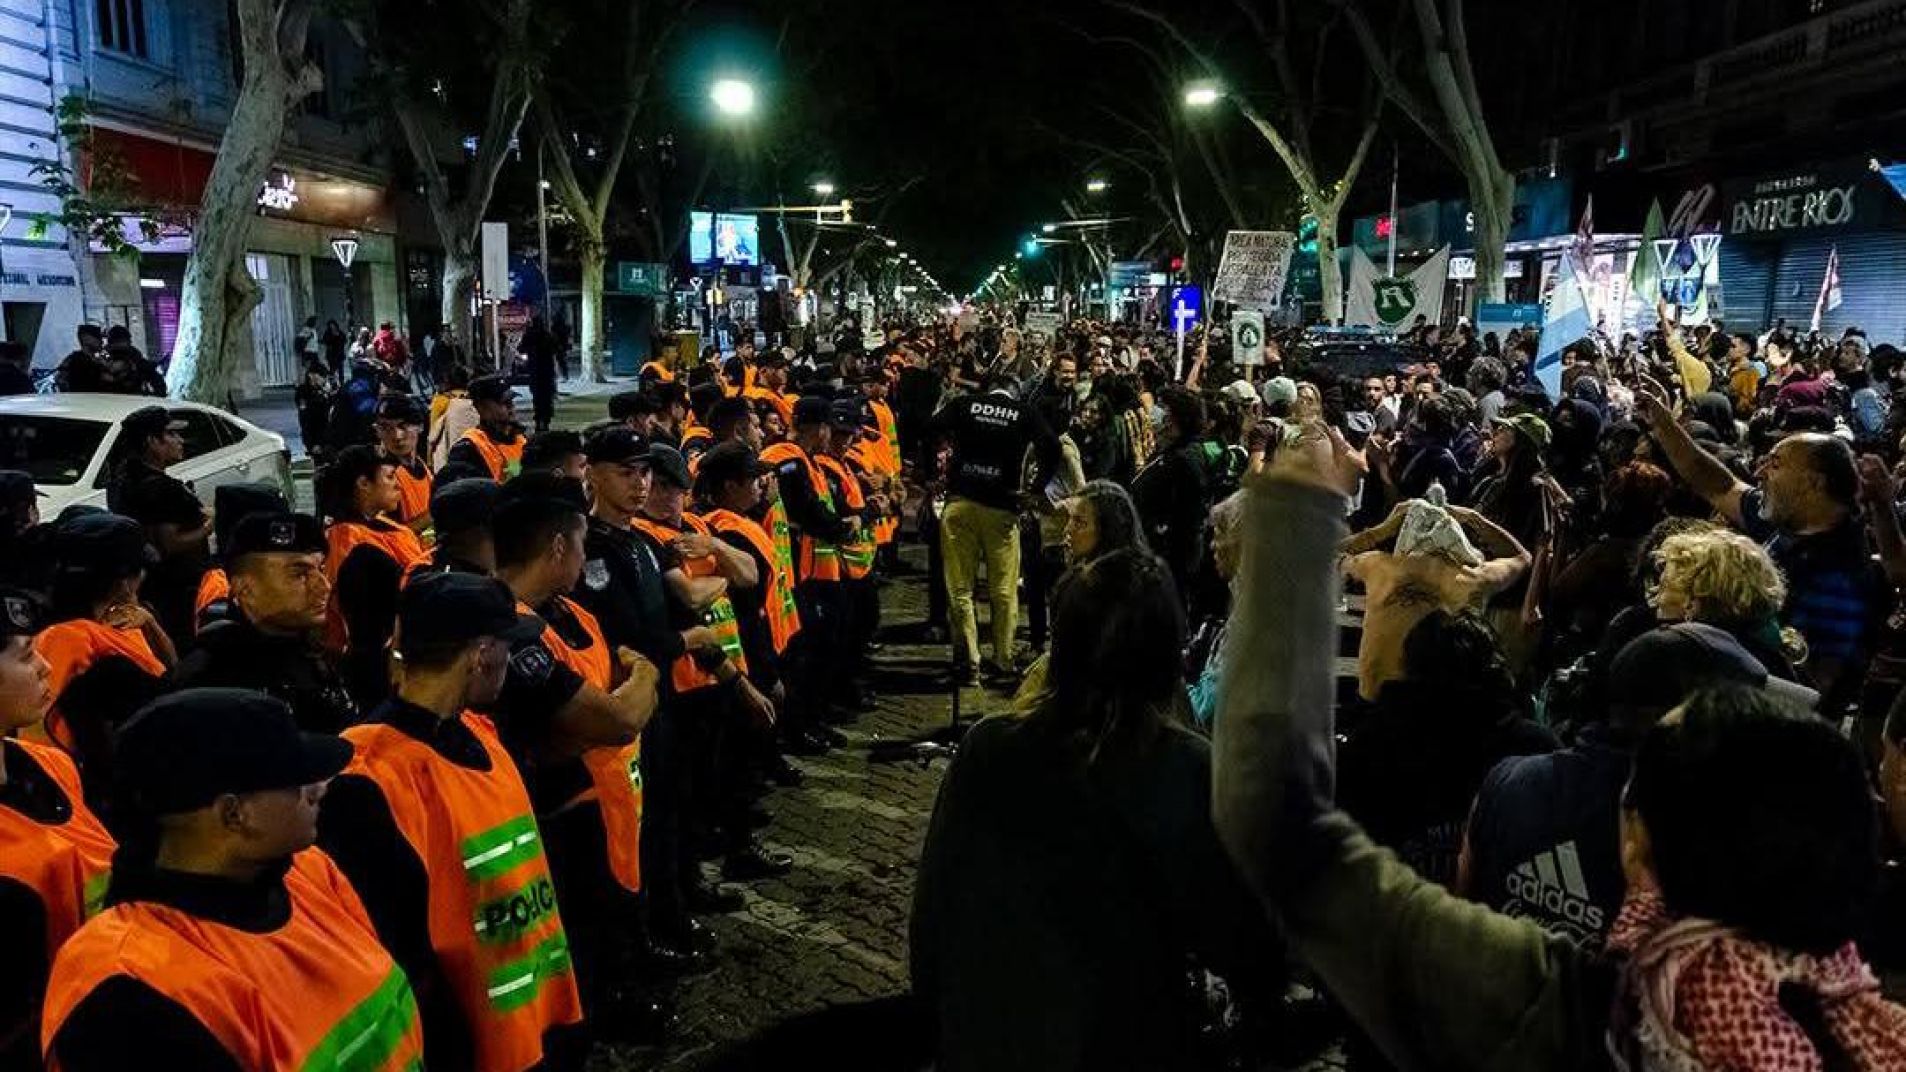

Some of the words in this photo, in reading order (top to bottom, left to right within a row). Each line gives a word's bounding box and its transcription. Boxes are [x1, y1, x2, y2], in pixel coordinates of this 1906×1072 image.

[1731, 195, 1801, 234] ENTRE
[1802, 186, 1856, 227] RIOS
[971, 402, 1020, 421] DDHH
[1506, 871, 1604, 929] adidas
